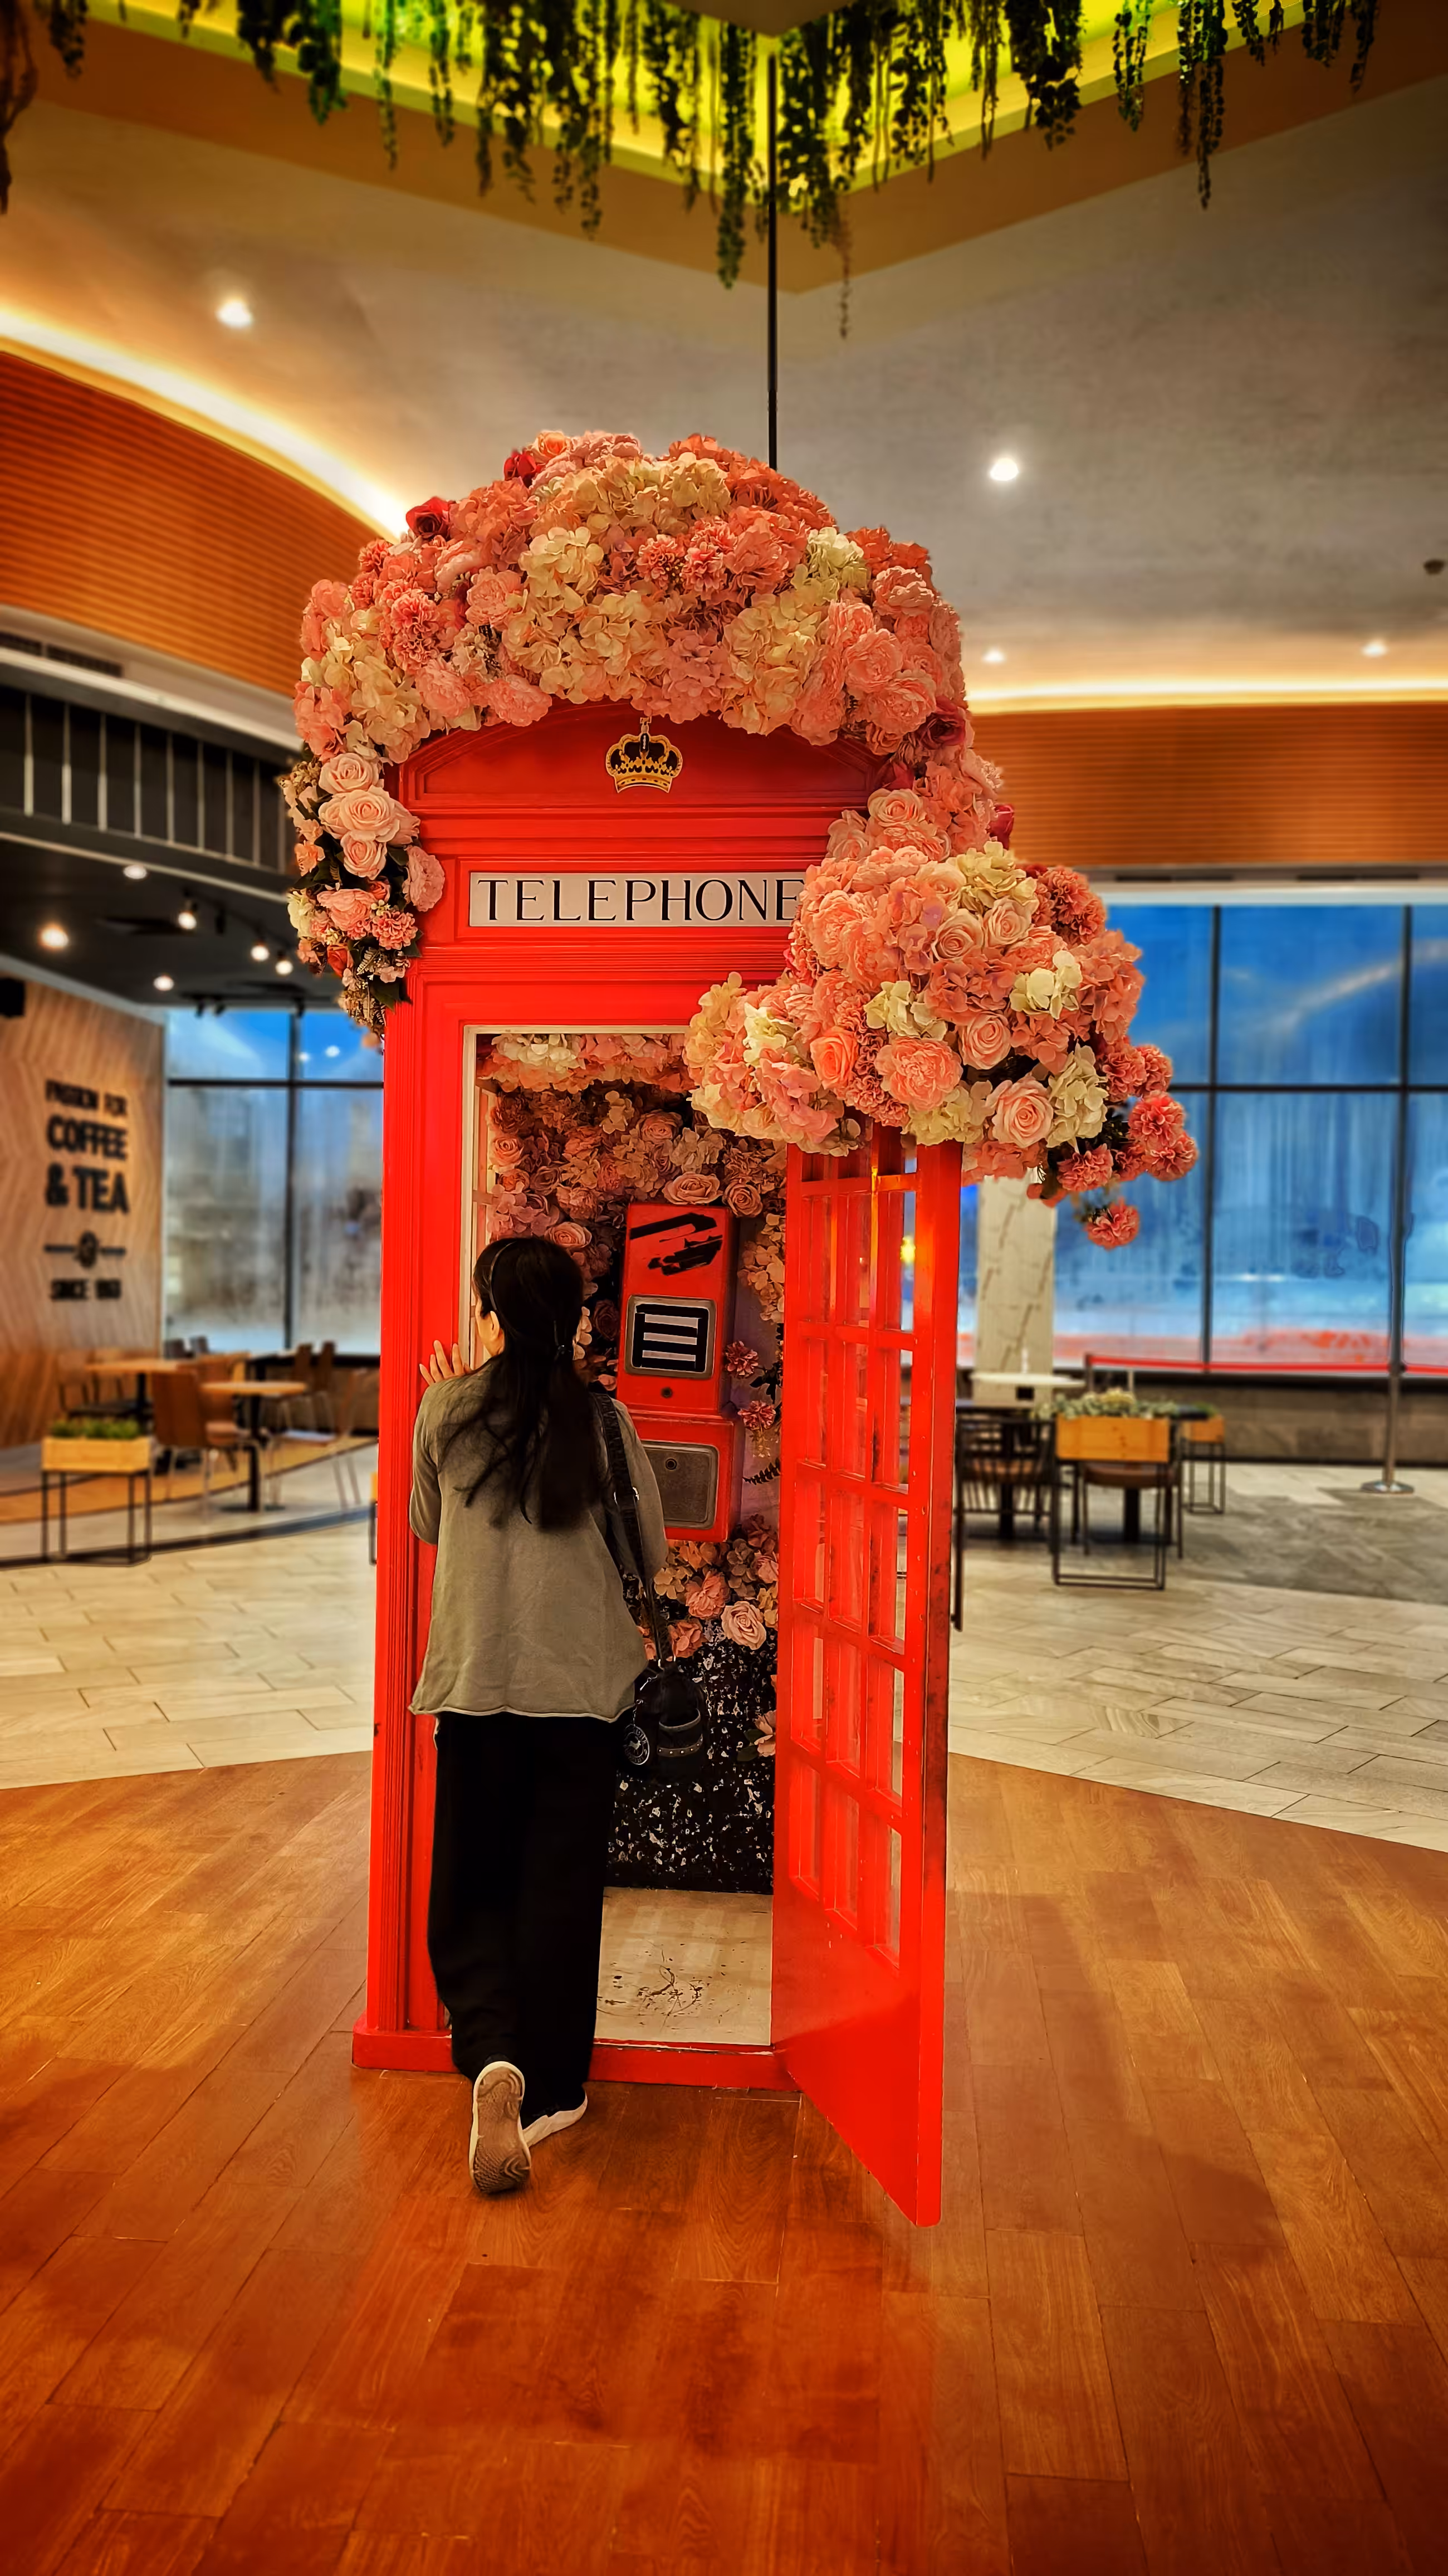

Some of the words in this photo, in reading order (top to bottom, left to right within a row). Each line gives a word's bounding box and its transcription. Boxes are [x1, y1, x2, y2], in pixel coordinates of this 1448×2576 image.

[477, 879, 805, 921] TELEPHONE
[46, 1115, 127, 1160] COFFEE
[45, 1163, 69, 1208] &
[72, 1165, 129, 1213] TEA
